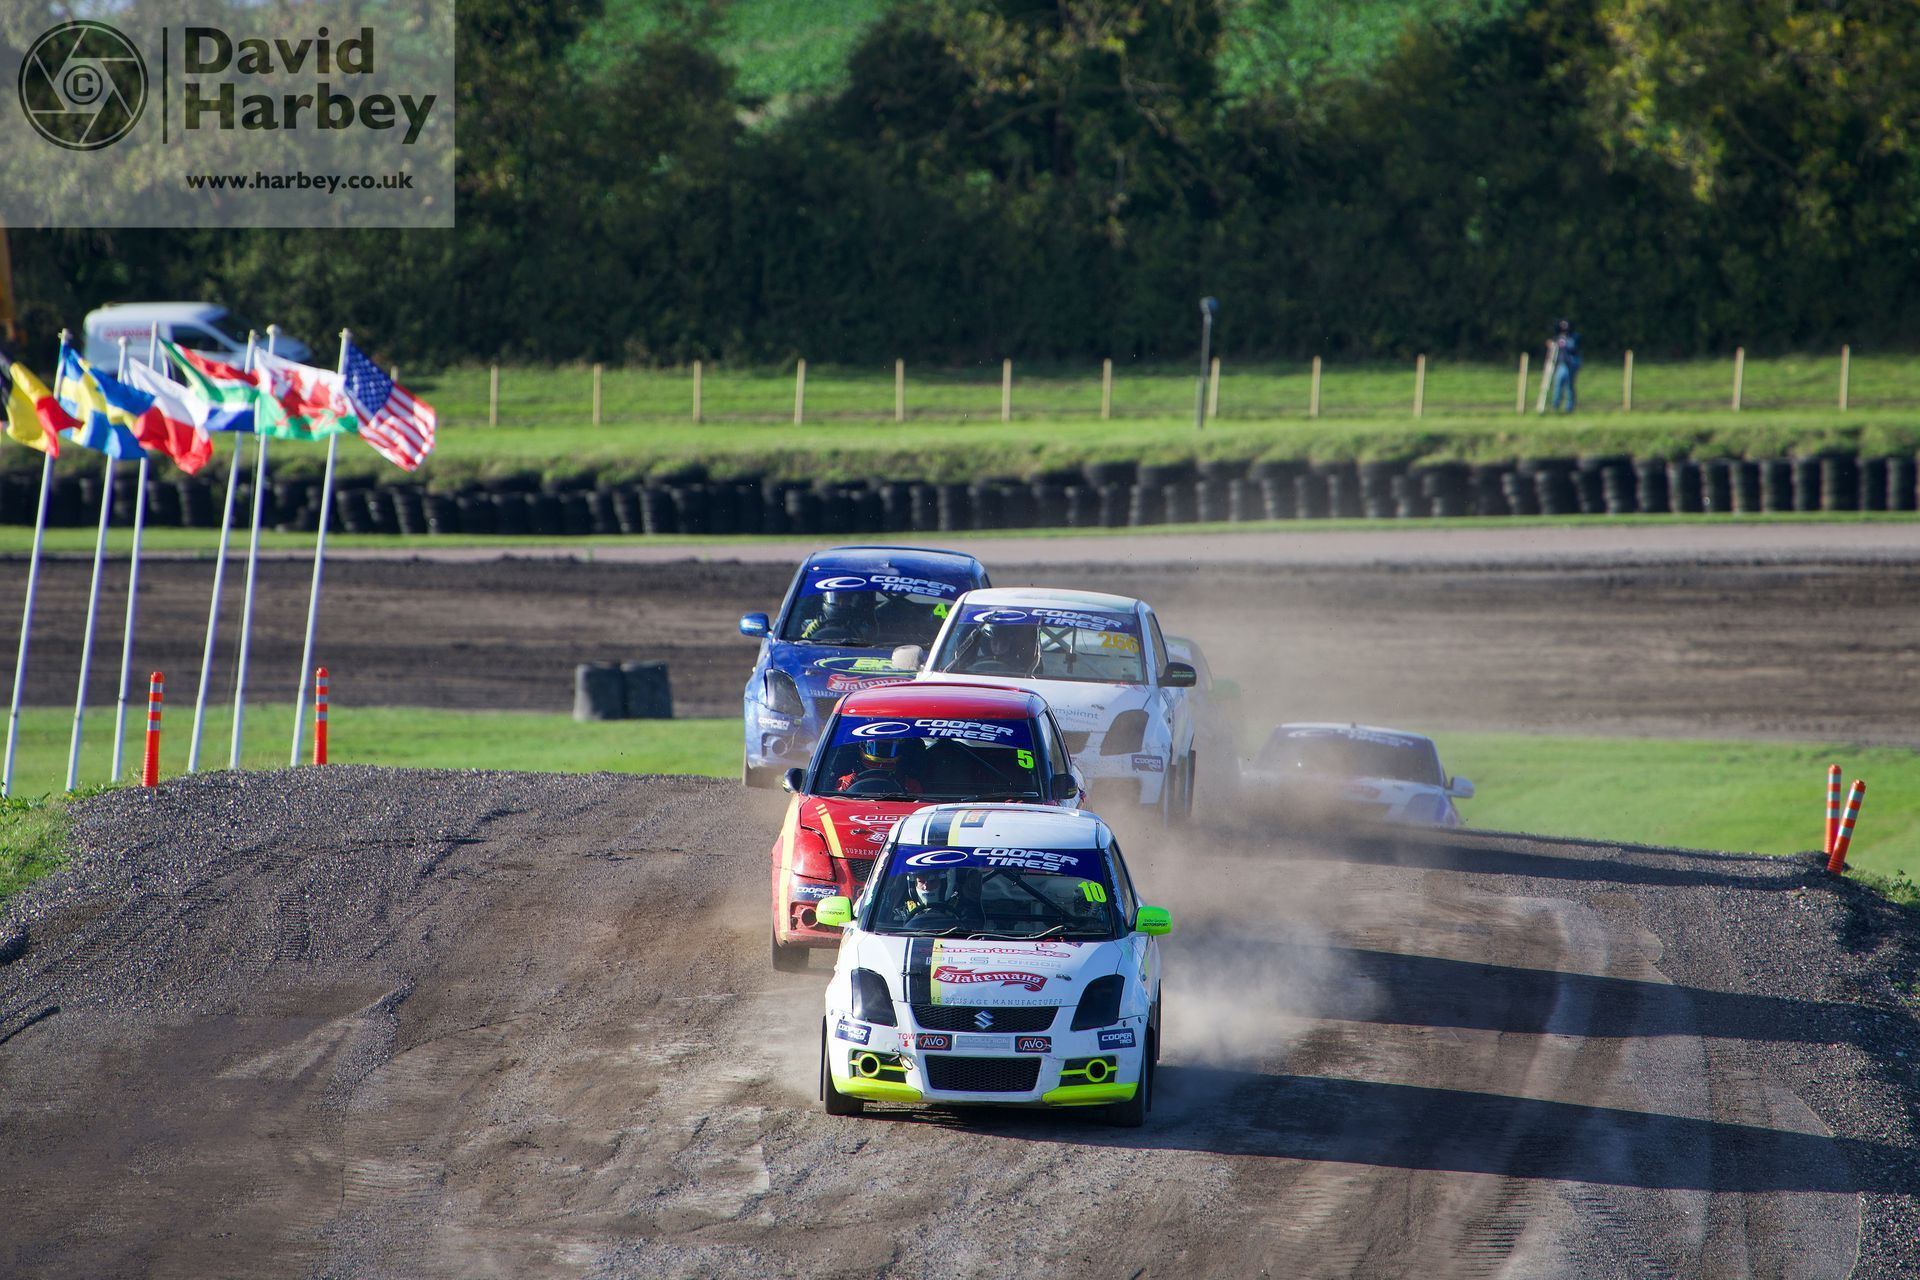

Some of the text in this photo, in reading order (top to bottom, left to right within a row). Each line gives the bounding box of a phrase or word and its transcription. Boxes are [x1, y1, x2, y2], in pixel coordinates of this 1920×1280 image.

[870, 575, 956, 593] COOPER
[881, 583, 943, 596] TIRES
[1031, 609, 1123, 628] COOPER
[1043, 617, 1107, 631] TIRES
[1099, 631, 1139, 653] 266
[914, 719, 1014, 737] COOPER
[928, 727, 998, 741] TIRES
[1017, 749, 1035, 769] 5
[972, 847, 1079, 866] COOPER
[986, 856, 1061, 872] TIRES
[797, 887, 836, 896] COOPER
[1078, 881, 1107, 904] 10
[945, 997, 987, 1005] SAUSAGE
[923, 1036, 944, 1047] AVO
[1023, 1038, 1043, 1050] AVO
[1101, 1032, 1133, 1041] COOPER
